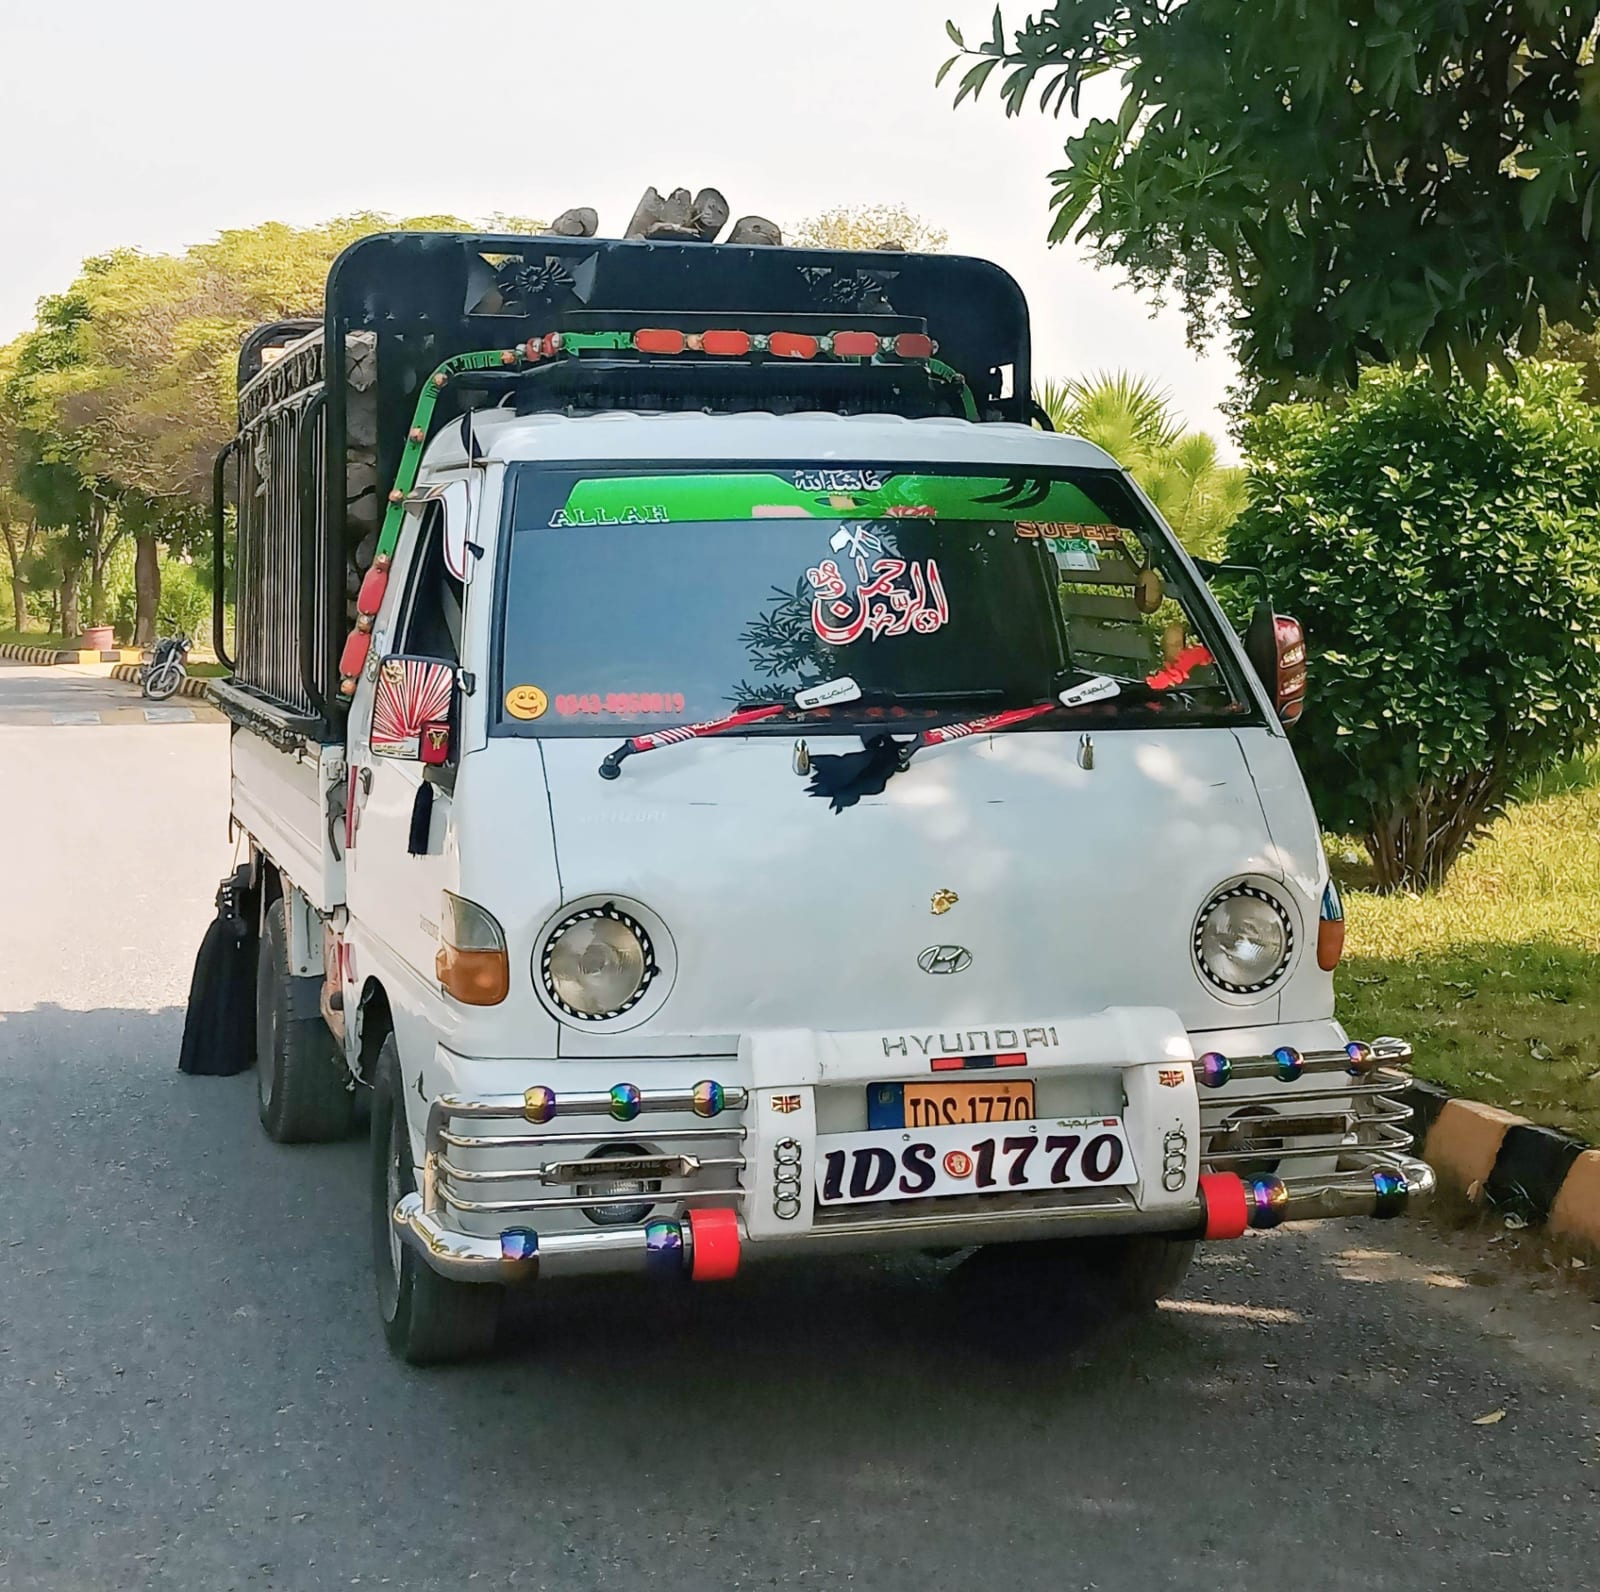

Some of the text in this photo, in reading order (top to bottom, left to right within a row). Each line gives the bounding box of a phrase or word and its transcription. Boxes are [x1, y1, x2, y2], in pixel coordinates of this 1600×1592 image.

[548, 504, 670, 528] ALLAH
[1013, 519, 1122, 541] SUPER
[882, 1026, 1059, 1057] HYUNDAI
[824, 1133, 1124, 1200] IDS 1770
